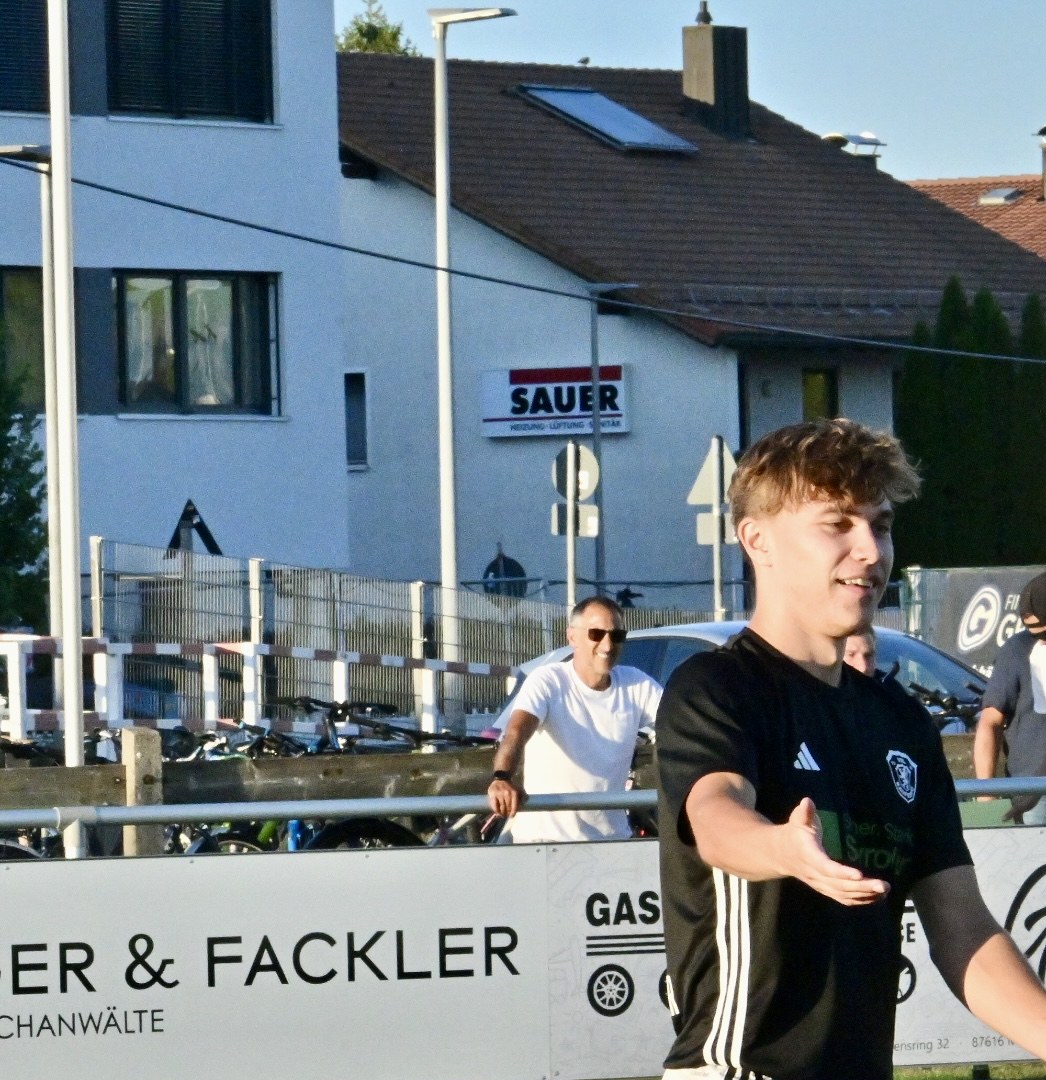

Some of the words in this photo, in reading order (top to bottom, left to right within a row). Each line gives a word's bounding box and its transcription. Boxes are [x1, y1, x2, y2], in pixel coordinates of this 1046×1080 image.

[510, 385, 620, 415] SAUER
[0, 941, 97, 995] ER
[125, 933, 180, 990] &
[206, 925, 521, 988] FACKLER
[937, 1038, 950, 1049] 32
[971, 1035, 1004, 1048] 87616
